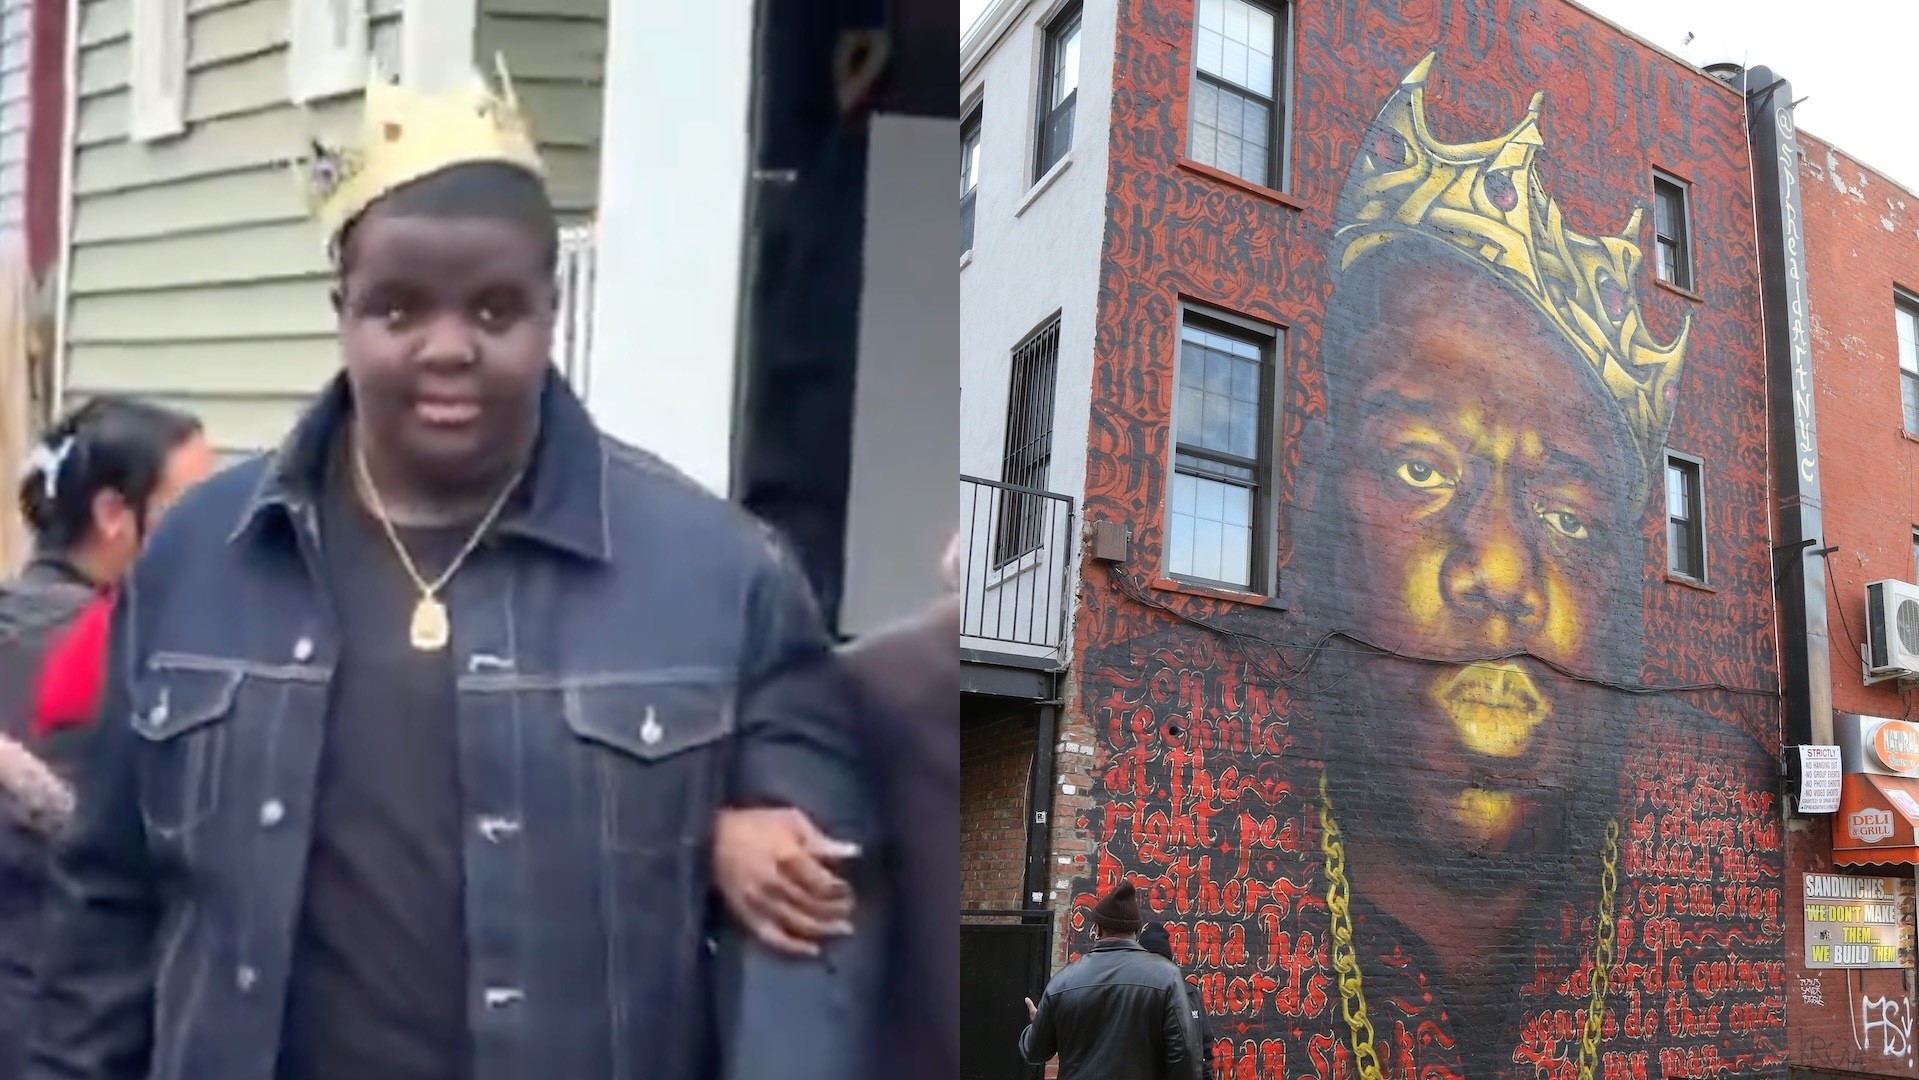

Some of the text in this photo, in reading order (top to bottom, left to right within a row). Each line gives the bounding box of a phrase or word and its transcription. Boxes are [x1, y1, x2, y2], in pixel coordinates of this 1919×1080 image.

[1808, 749, 1836, 757] STRICTLY
[1853, 815, 1889, 825] DELI
[1860, 826, 1890, 835] GRILL
[1807, 904, 1895, 923] WE DON'T MAKE
[1812, 945, 1896, 964] WE BUILD THEM
